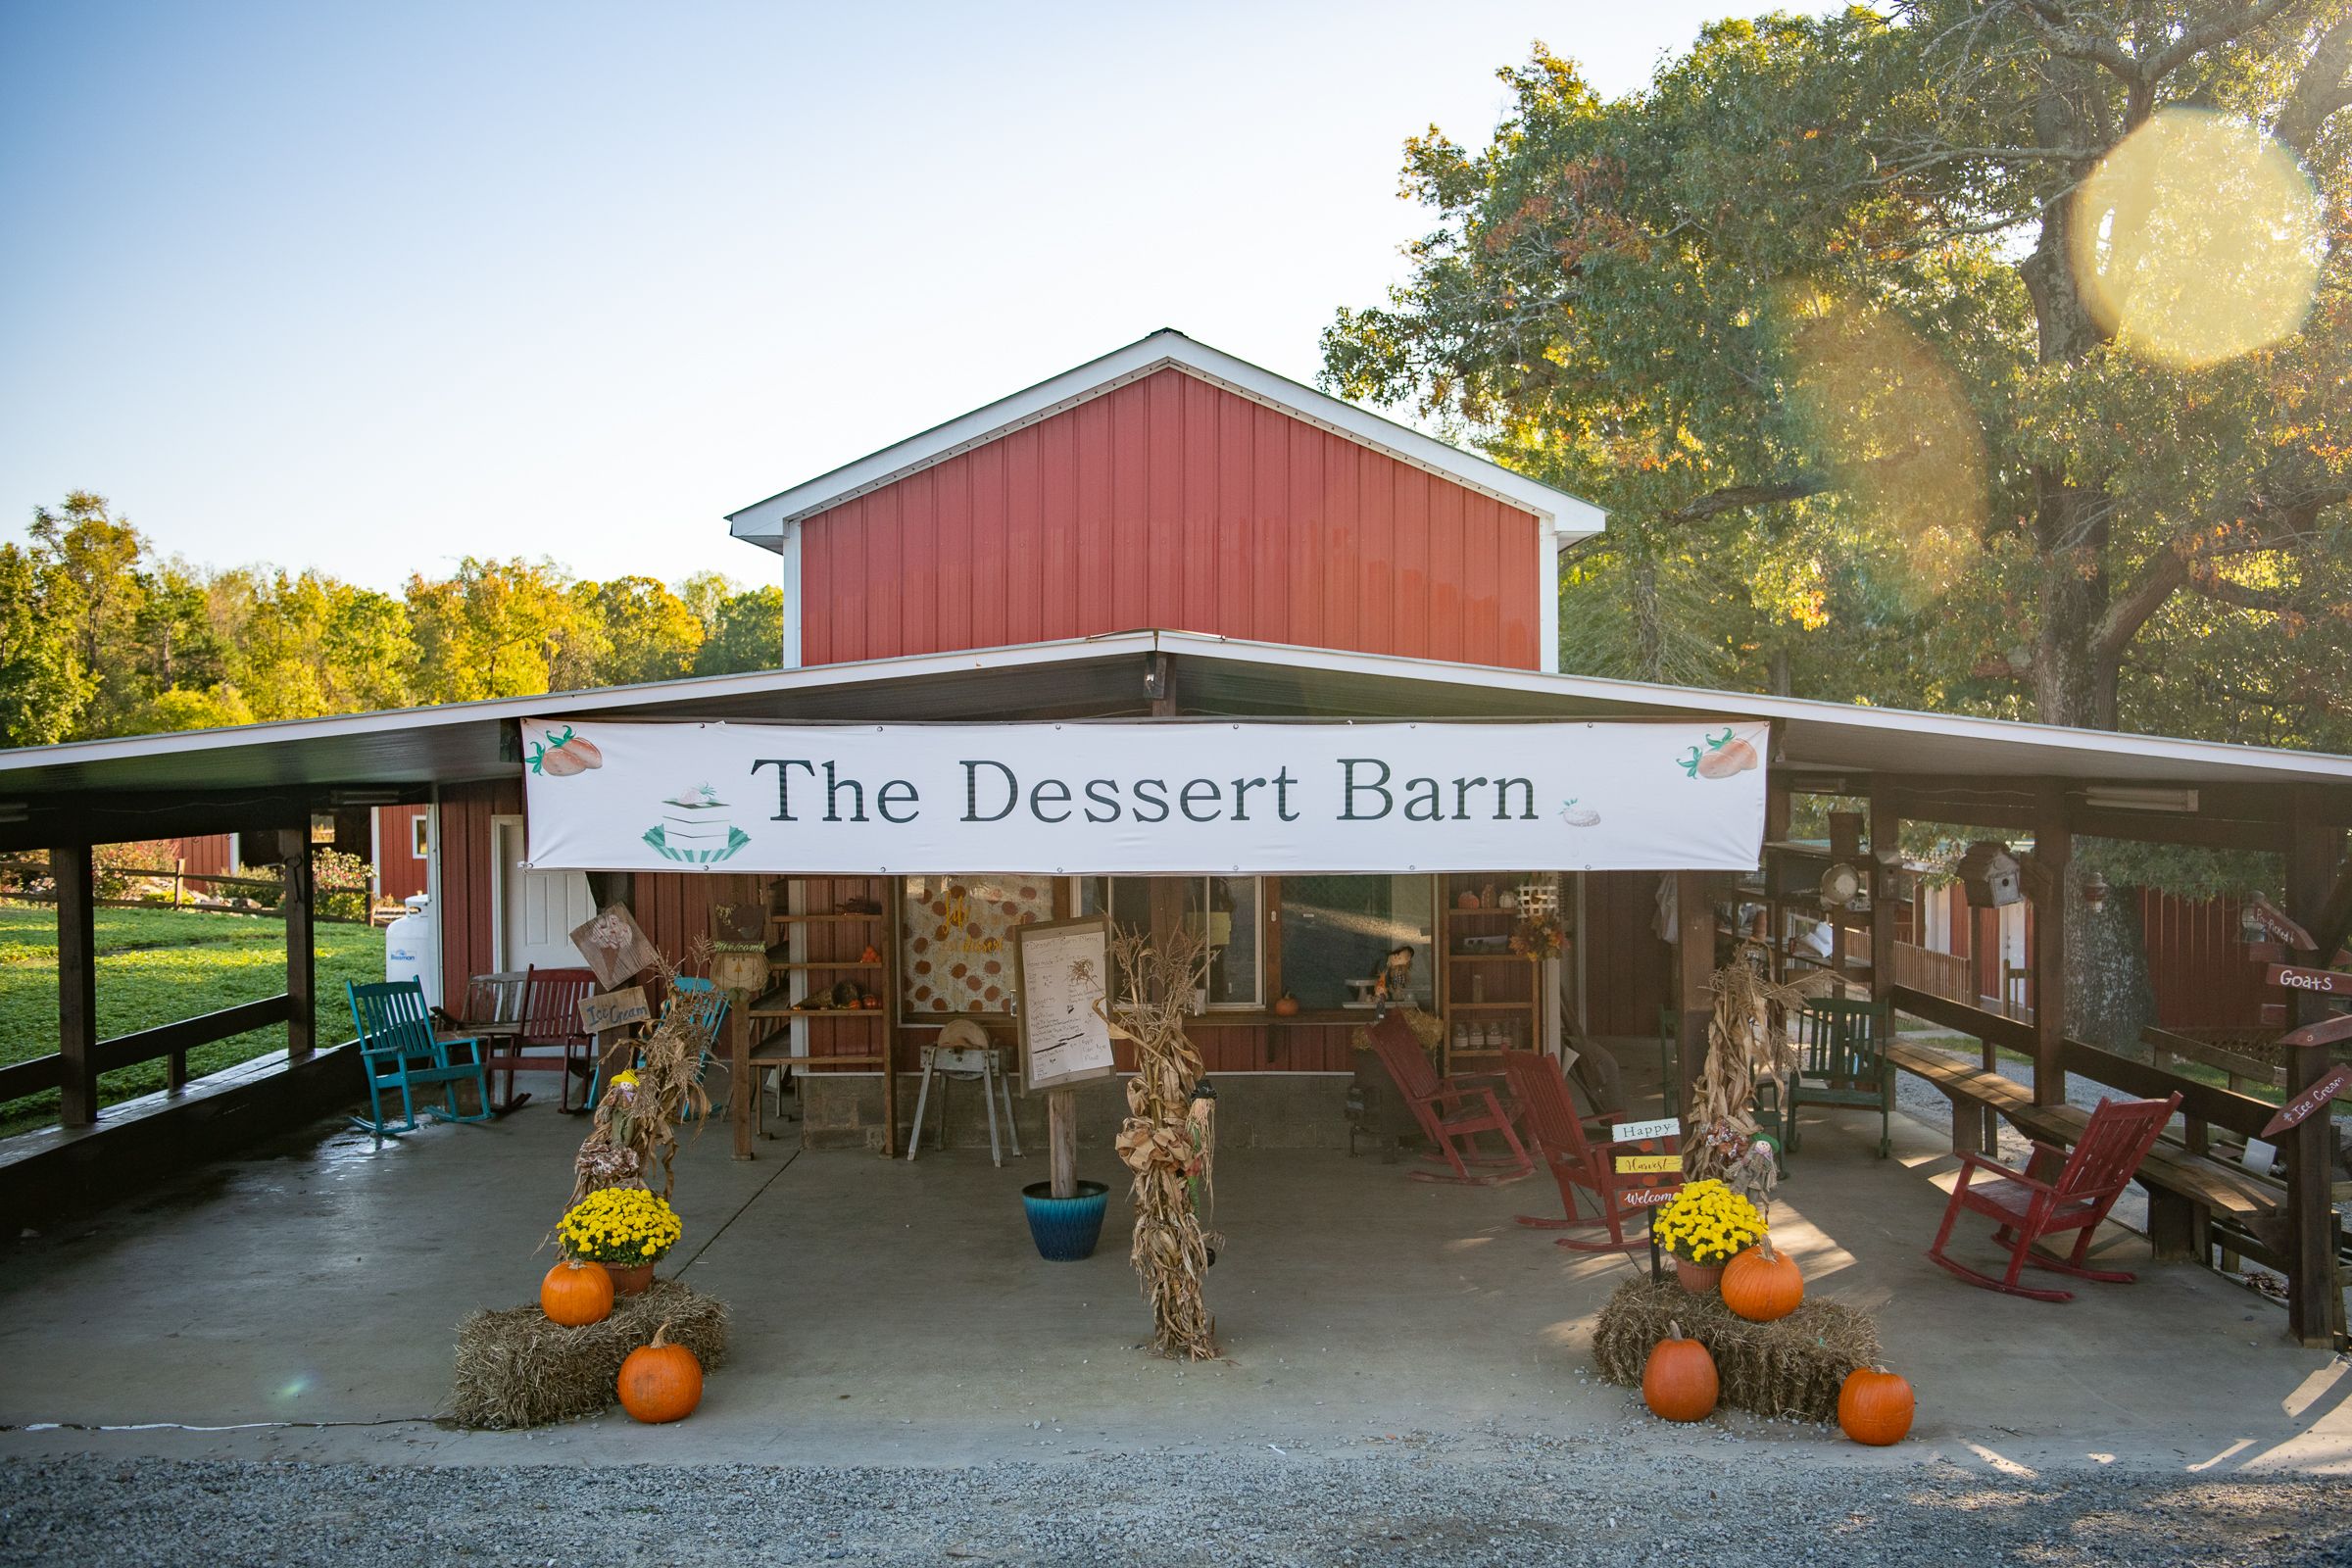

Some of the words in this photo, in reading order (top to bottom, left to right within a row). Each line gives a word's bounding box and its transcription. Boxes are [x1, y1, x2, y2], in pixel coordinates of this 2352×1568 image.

[751, 760, 919, 823] The
[958, 760, 1300, 823] Dessert
[1336, 759, 1540, 822] Barn
[2279, 969, 2332, 991] Goats
[586, 1004, 609, 1026] Ice
[609, 1004, 647, 1024] Cream
[2293, 1101, 2314, 1119] Ice
[2313, 1076, 2345, 1102] Cream
[1623, 1123, 1671, 1137] Happy
[1626, 1157, 1673, 1171] Harvest
